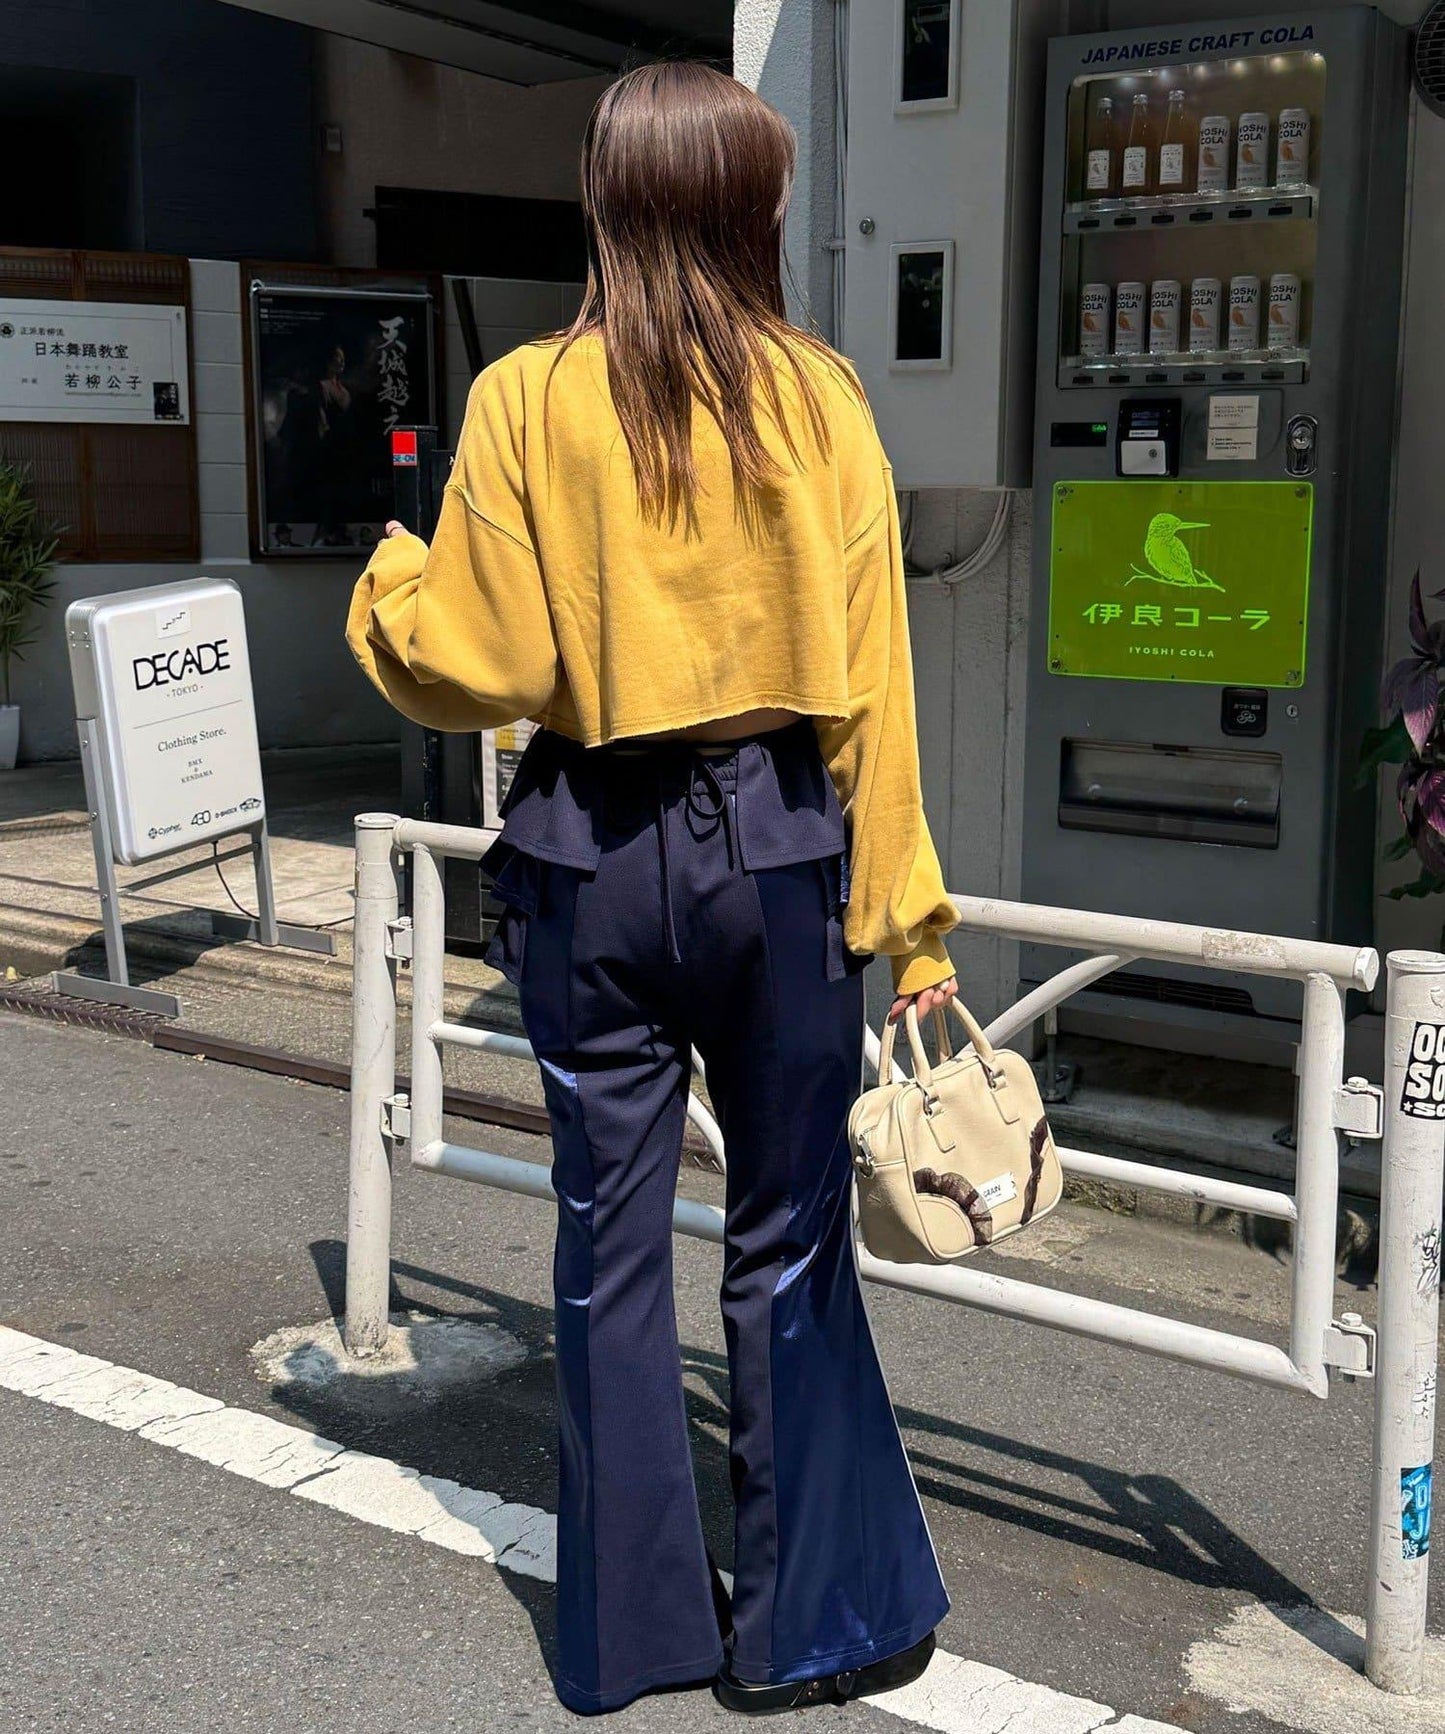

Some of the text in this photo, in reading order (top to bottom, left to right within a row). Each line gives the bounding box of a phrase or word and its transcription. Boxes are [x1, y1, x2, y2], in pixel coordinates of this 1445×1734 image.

[1082, 25, 1315, 65] JAPANESE CRAFT COLA
[35, 342, 129, 359] 日本舞踊教室
[65, 373, 143, 390] 若柳公子
[1082, 603, 1271, 630] 伊良コーラ
[133, 639, 231, 690] DECADE
[1129, 646, 1215, 659] IYOSHI COLA
[157, 727, 227, 753] Clothing Store.
